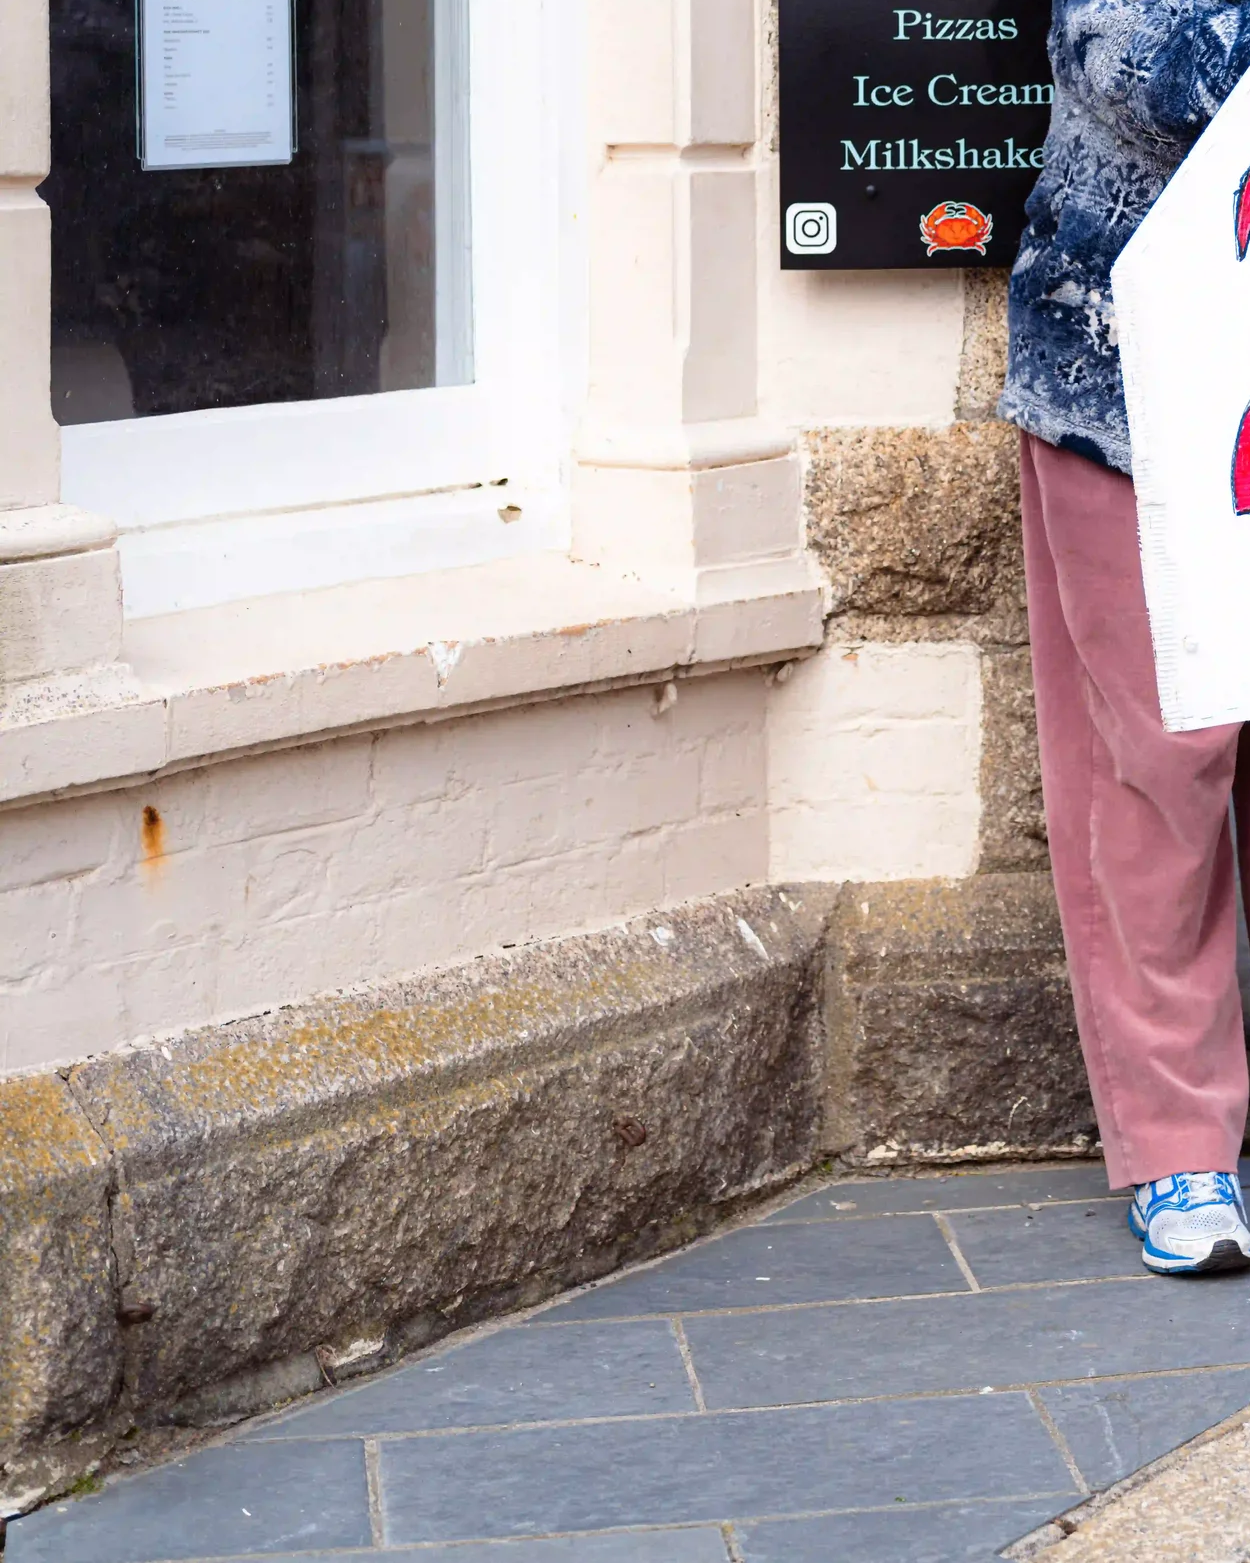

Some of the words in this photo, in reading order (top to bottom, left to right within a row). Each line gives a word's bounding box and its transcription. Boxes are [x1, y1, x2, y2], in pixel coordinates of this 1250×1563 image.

[892, 9, 1018, 41] Pizzas
[852, 75, 914, 107] Ice
[927, 74, 1056, 107] Cream
